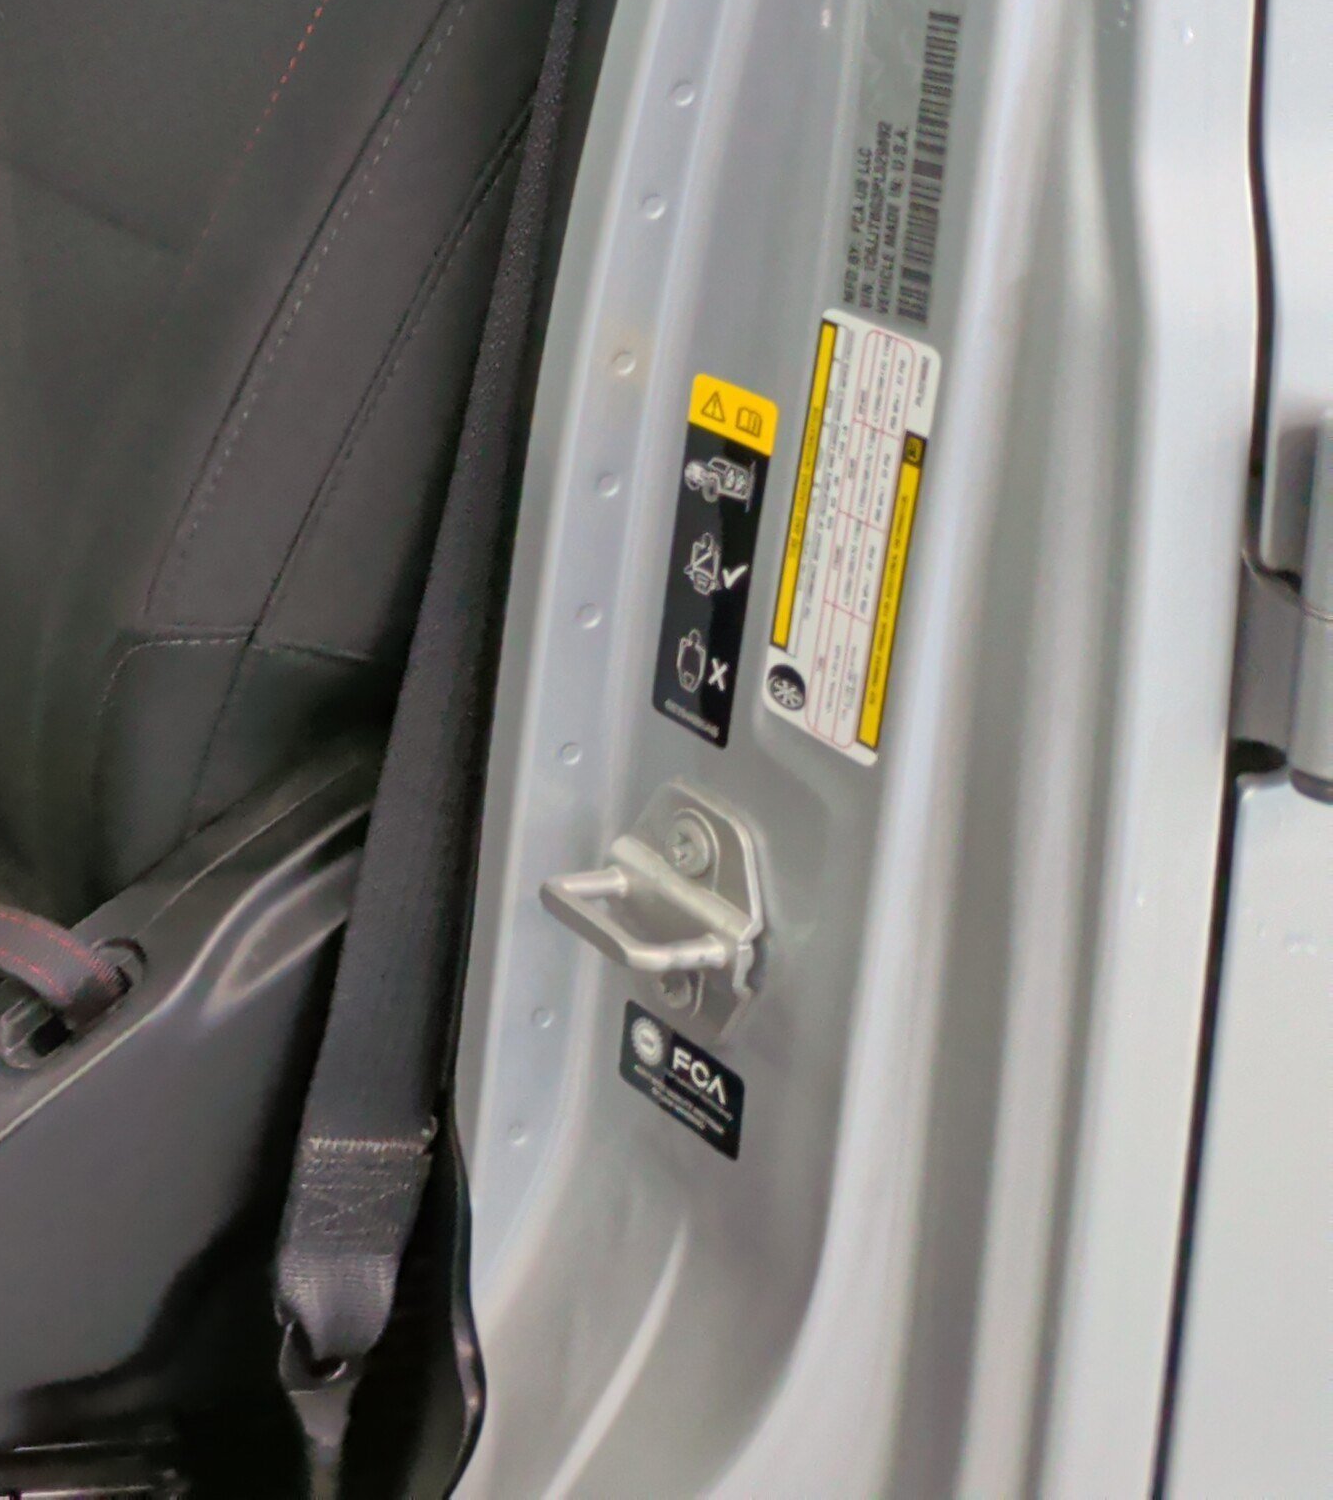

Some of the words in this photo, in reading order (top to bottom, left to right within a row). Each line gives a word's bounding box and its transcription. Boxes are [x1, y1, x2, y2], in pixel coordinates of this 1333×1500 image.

[857, 147, 872, 175] LLC
[876, 253, 895, 315] VEHICLE
[671, 1046, 727, 1106] FCA
